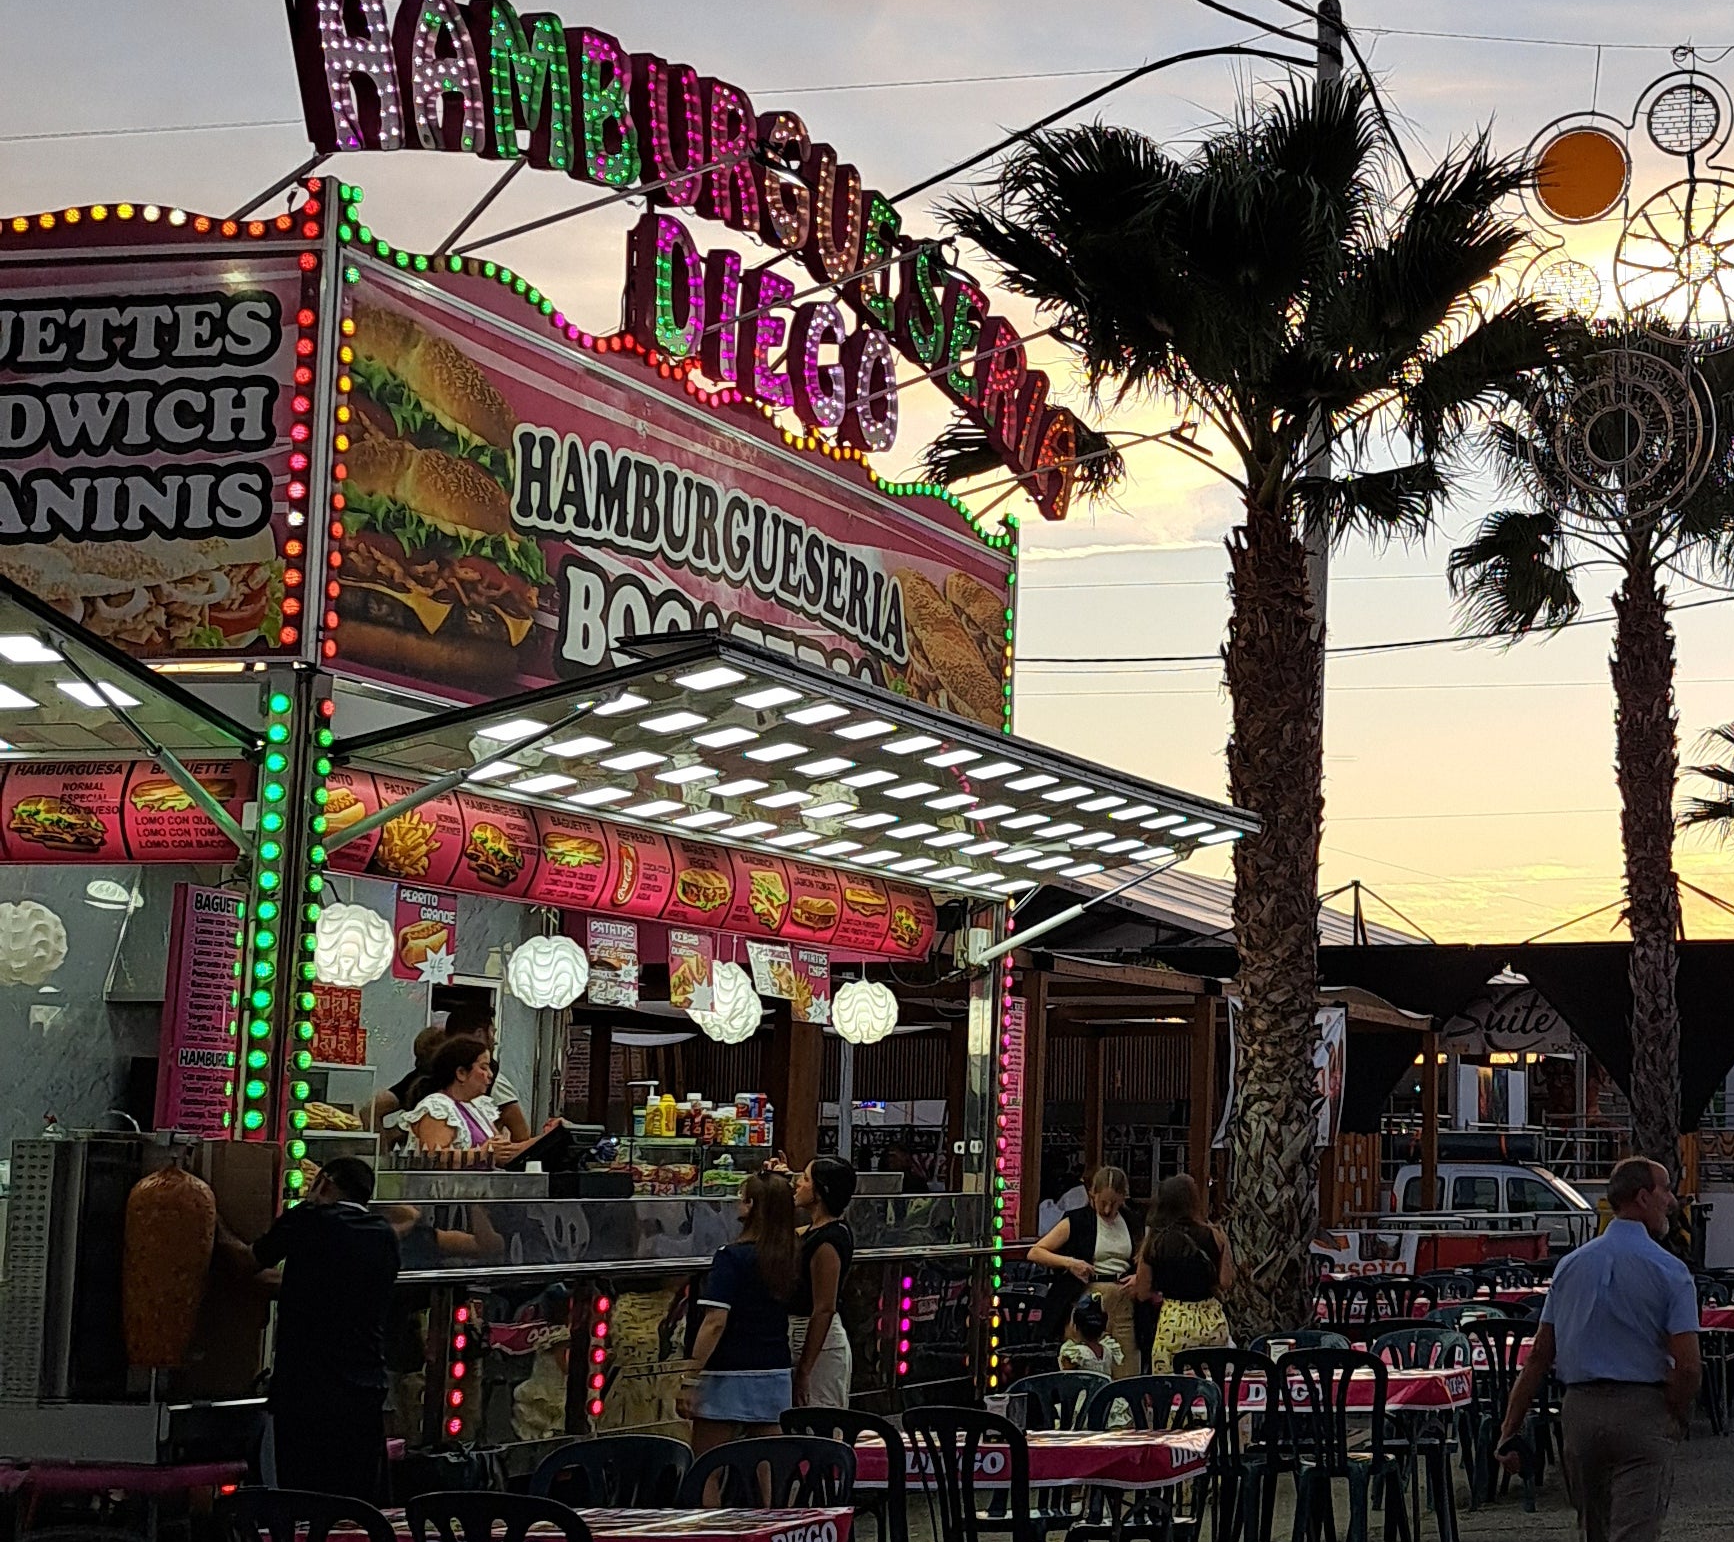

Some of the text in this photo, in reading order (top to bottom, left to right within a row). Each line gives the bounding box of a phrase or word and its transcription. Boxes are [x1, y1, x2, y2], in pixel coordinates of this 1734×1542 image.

[640, 214, 898, 452] DIEGO
[513, 427, 910, 662] HAMBURGUESERIA
[15, 763, 123, 776] HAMBURGUESA
[62, 782, 105, 791] NORMAL
[135, 816, 164, 826] LOMO
[167, 816, 189, 825] CON
[137, 828, 166, 837] LOMO
[169, 828, 191, 837] CON
[139, 840, 169, 849] LOMO
[171, 840, 193, 849] CON
[401, 889, 438, 906] PERRITO
[421, 907, 456, 925] GRANDE
[591, 921, 634, 937] PATATAS
[1447, 991, 1558, 1047] Suite
